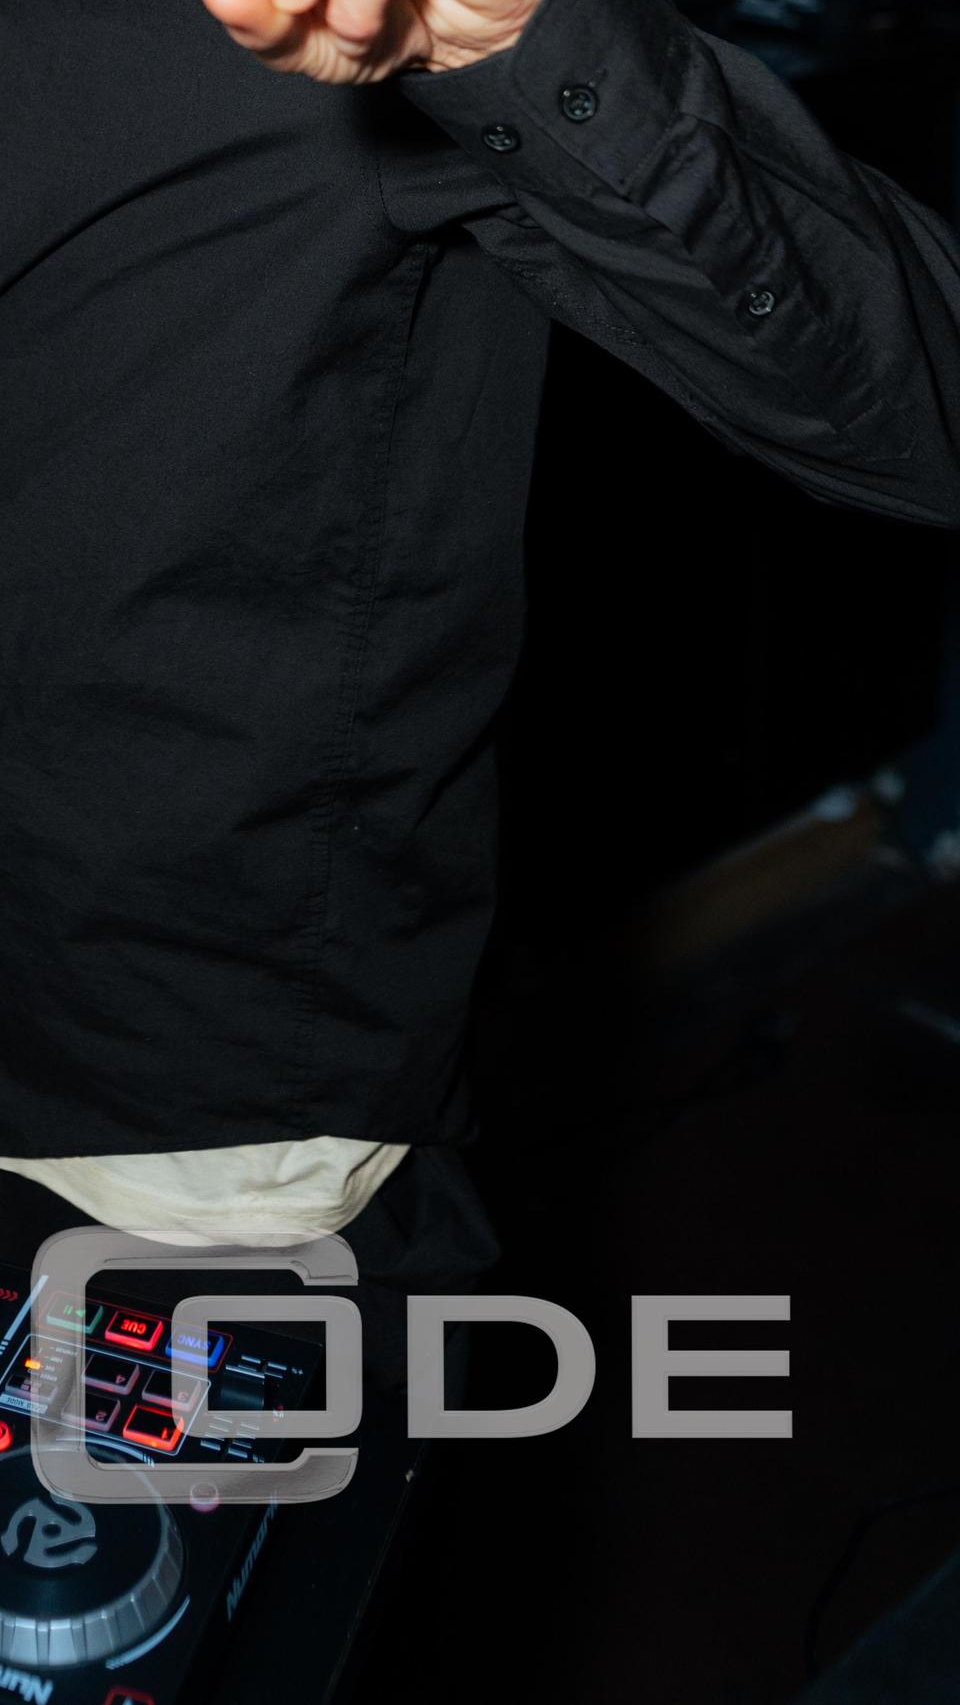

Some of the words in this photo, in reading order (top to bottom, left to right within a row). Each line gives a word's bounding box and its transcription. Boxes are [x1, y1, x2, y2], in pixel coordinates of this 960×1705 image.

[121, 1319, 147, 1335] CUE
[177, 1334, 211, 1351] SYNC
[114, 1373, 126, 1384] 4
[96, 1409, 108, 1421] 2
[160, 1425, 170, 1440] 1
